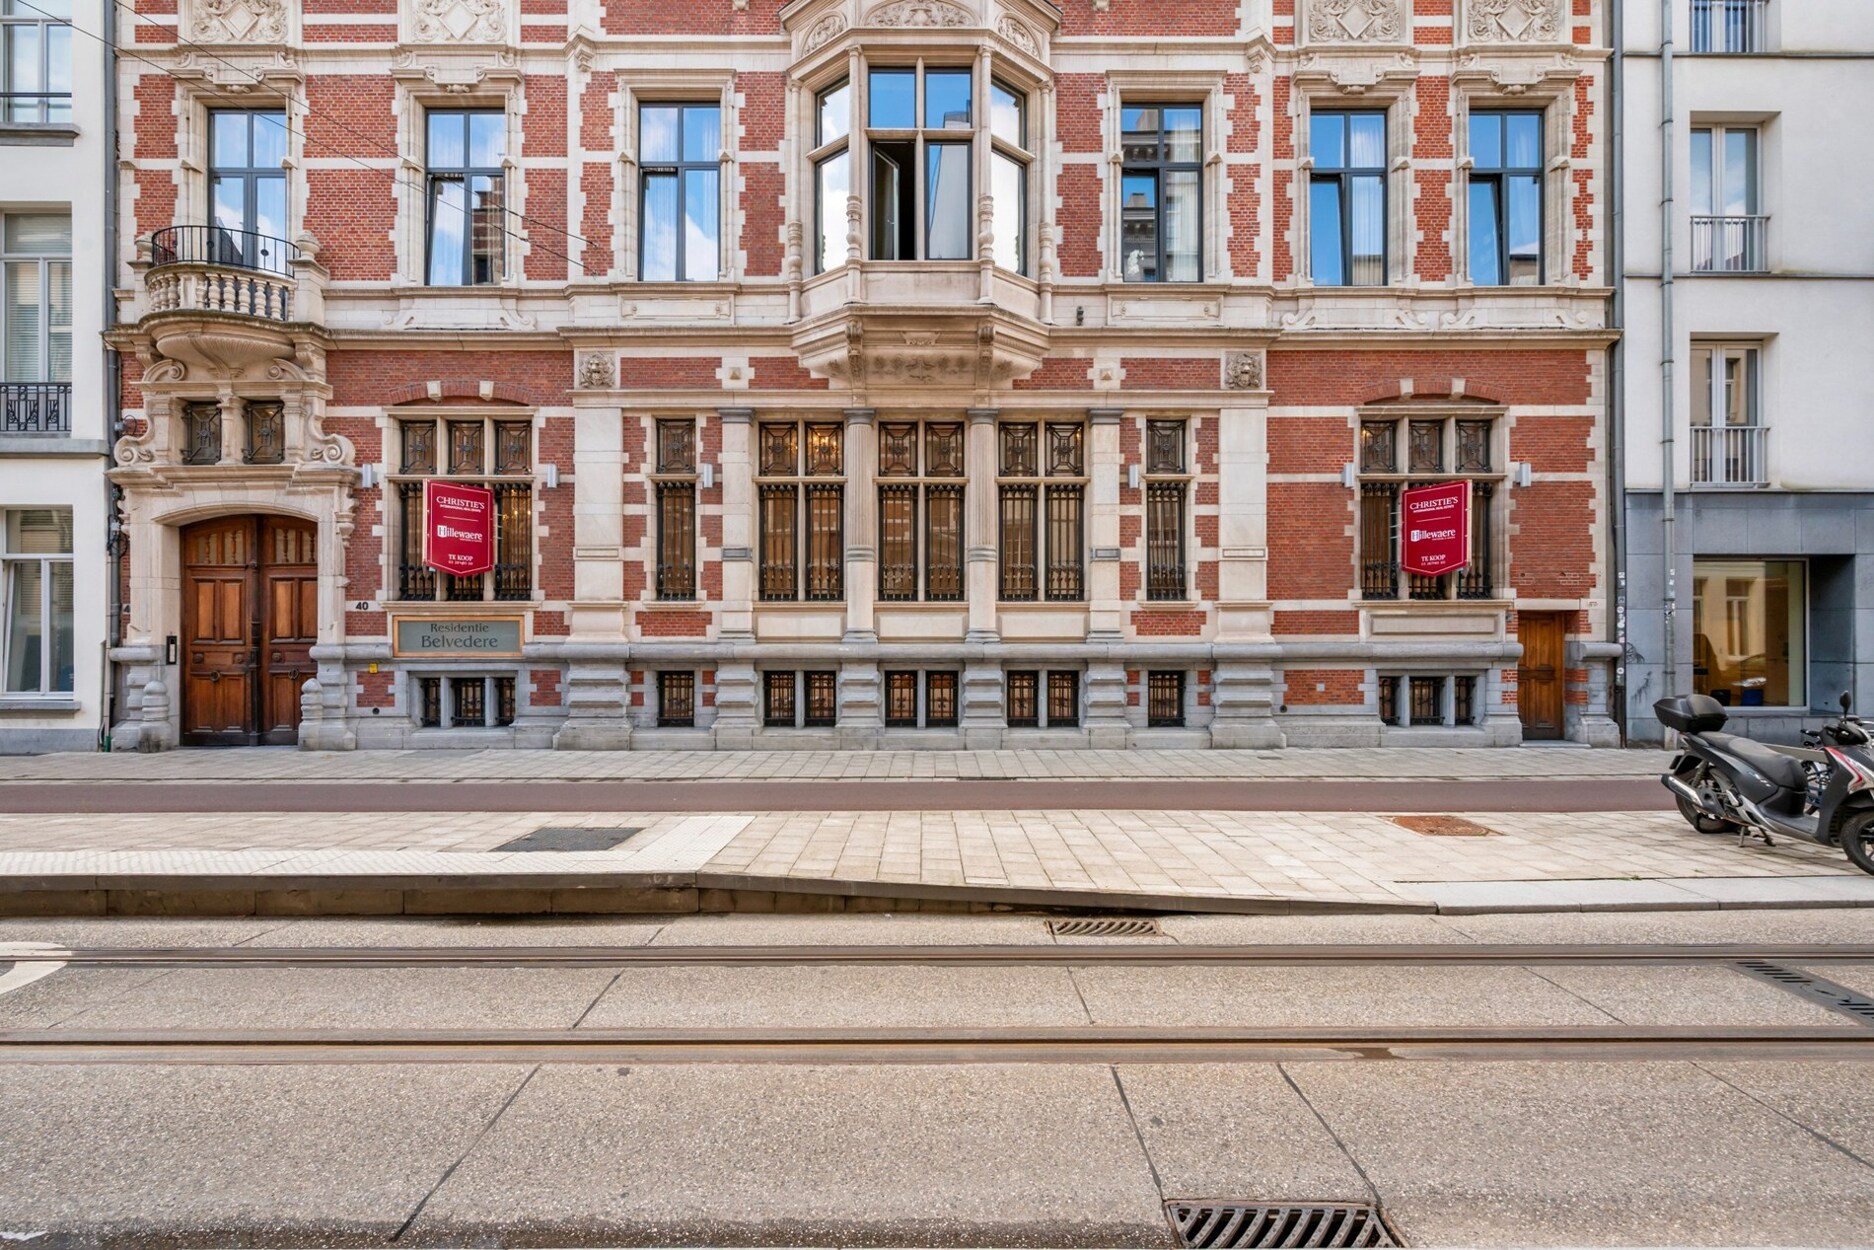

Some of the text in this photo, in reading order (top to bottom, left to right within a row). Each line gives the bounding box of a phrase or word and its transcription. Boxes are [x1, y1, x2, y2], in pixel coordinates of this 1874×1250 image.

[436, 496, 485, 509] CHRISTIE'S
[1410, 496, 1458, 510] CHRISTIE'S
[437, 524, 482, 540] Hillewaere
[1410, 529, 1456, 542] Hillewaere
[356, 602, 368, 610] 40
[430, 623, 489, 633] Residentie
[421, 634, 499, 648] Belvedere
